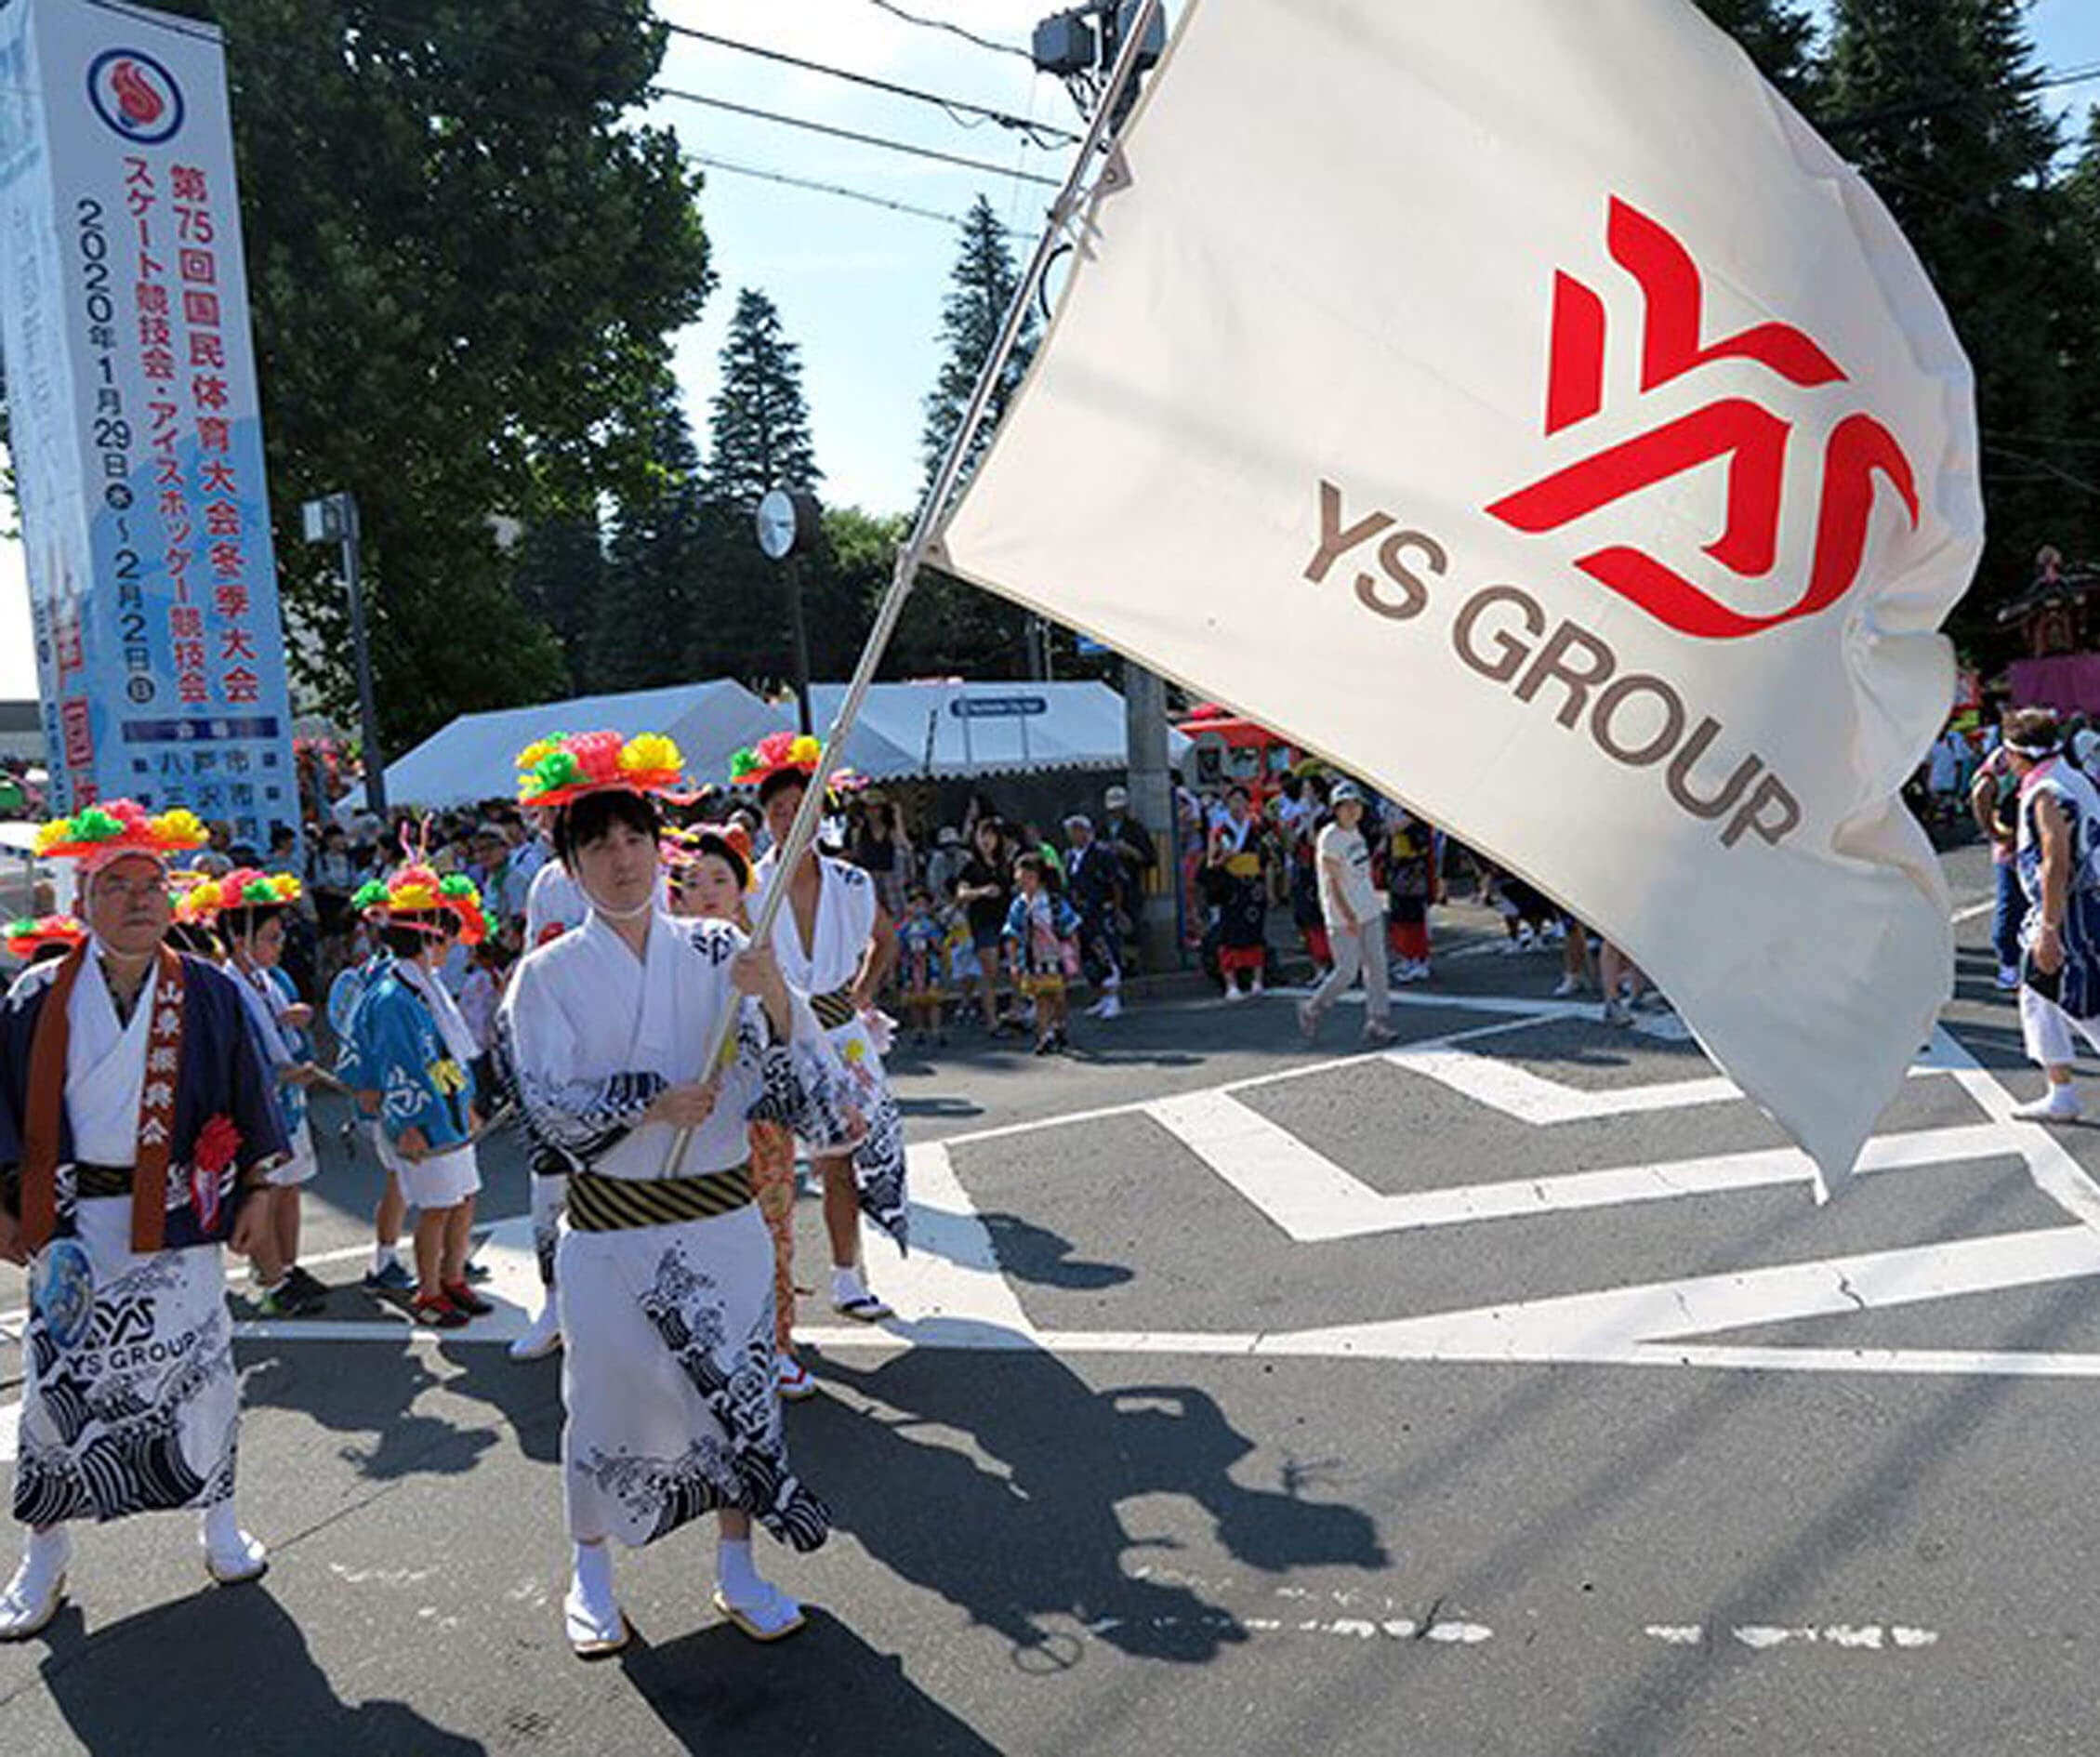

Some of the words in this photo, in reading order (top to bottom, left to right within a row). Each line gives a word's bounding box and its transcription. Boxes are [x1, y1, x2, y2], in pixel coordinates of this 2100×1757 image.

[170, 165, 258, 703] 第75回国民体育大会冬季大会
[1303, 479, 1448, 620] YS
[1452, 585, 1801, 849] GROUP
[66, 1354, 103, 1377] YS
[109, 1330, 197, 1369] GROUP
